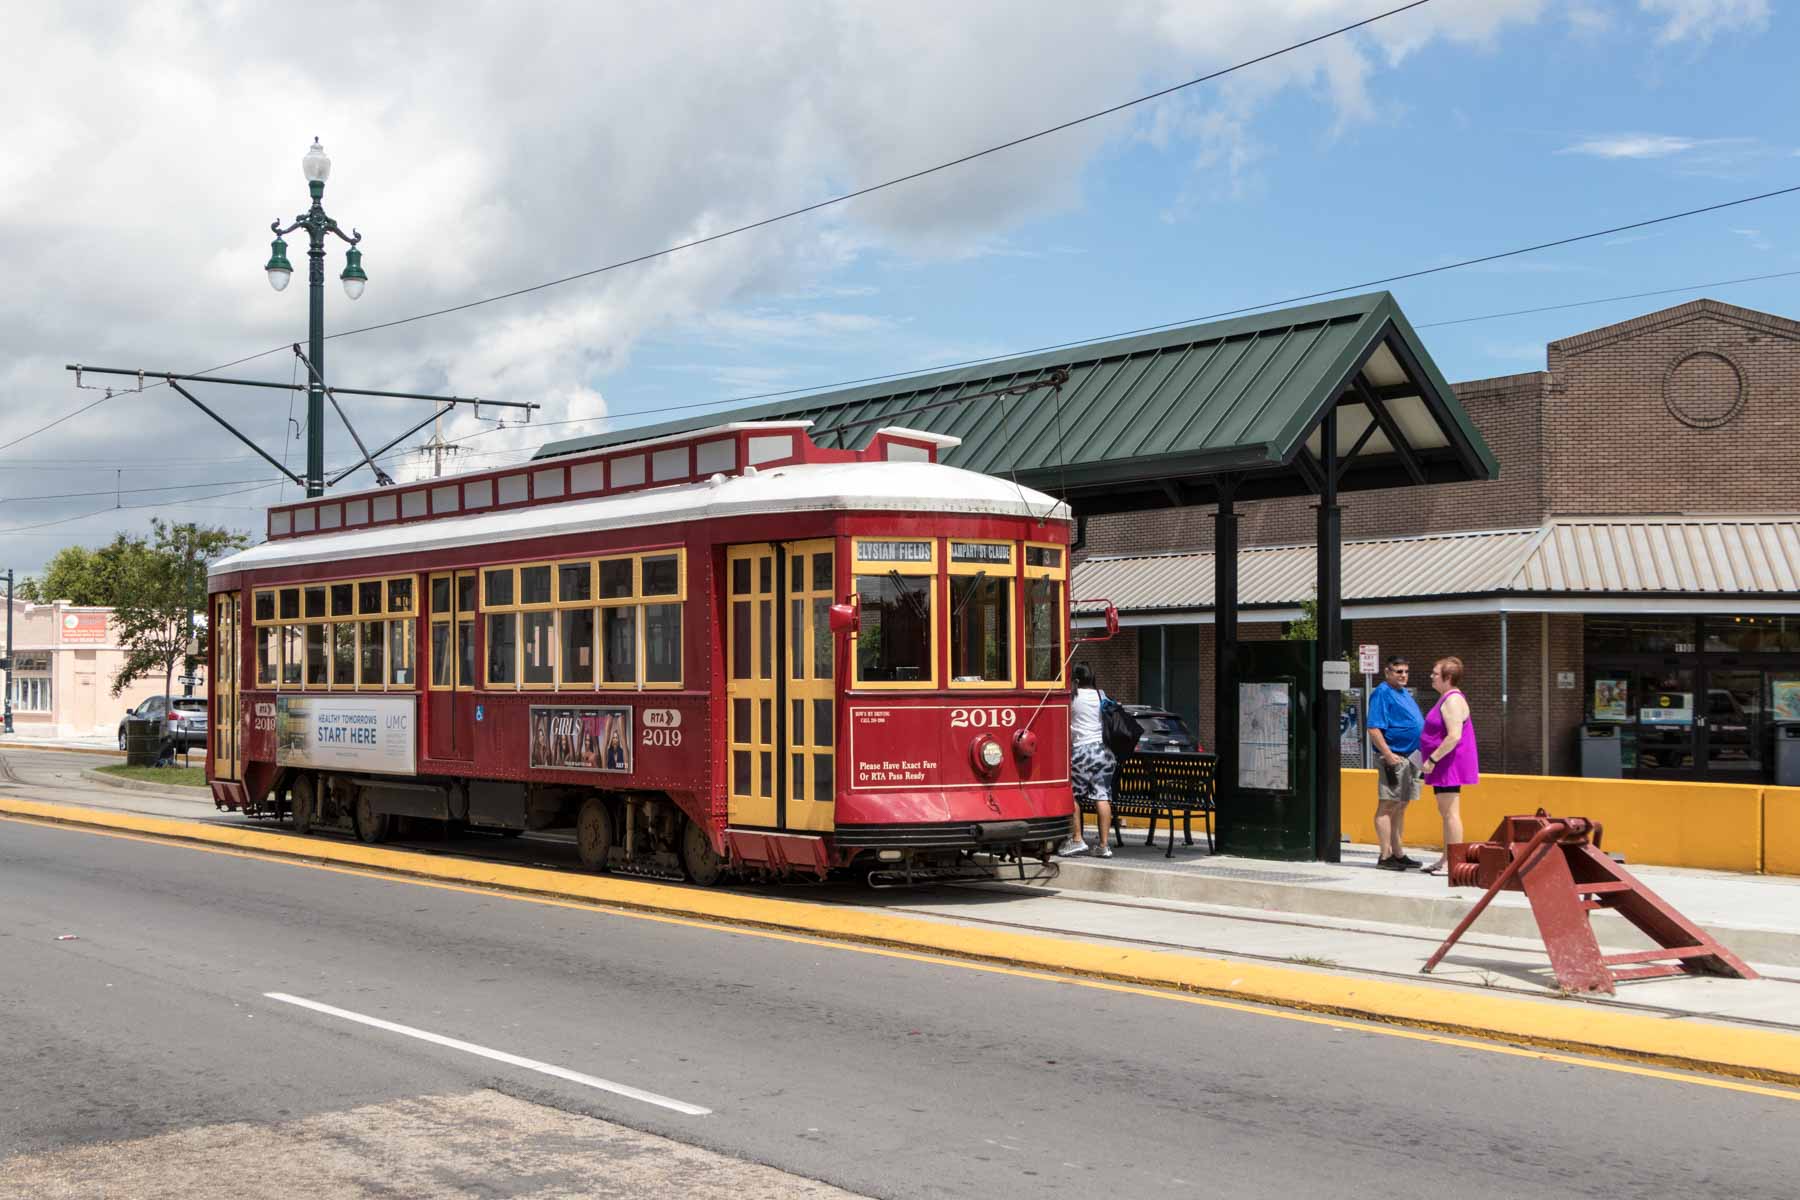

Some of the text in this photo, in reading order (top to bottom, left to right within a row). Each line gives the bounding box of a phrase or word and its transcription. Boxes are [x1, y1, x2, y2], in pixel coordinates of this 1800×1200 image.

[857, 543, 931, 560] ELYSIAN FIELDS
[988, 545, 1010, 559] CLAUDE
[318, 714, 377, 724] HEALTHY TOMORROWS
[386, 715, 407, 729] UMC
[650, 712, 665, 723] RTA
[951, 709, 1016, 728] 2019
[551, 716, 583, 736] GIRLS
[318, 727, 376, 744] START HERE
[643, 729, 681, 746] 2019
[859, 760, 937, 770] Please Have Exact Fare
[859, 772, 925, 782] Or RTA Pass Ready
